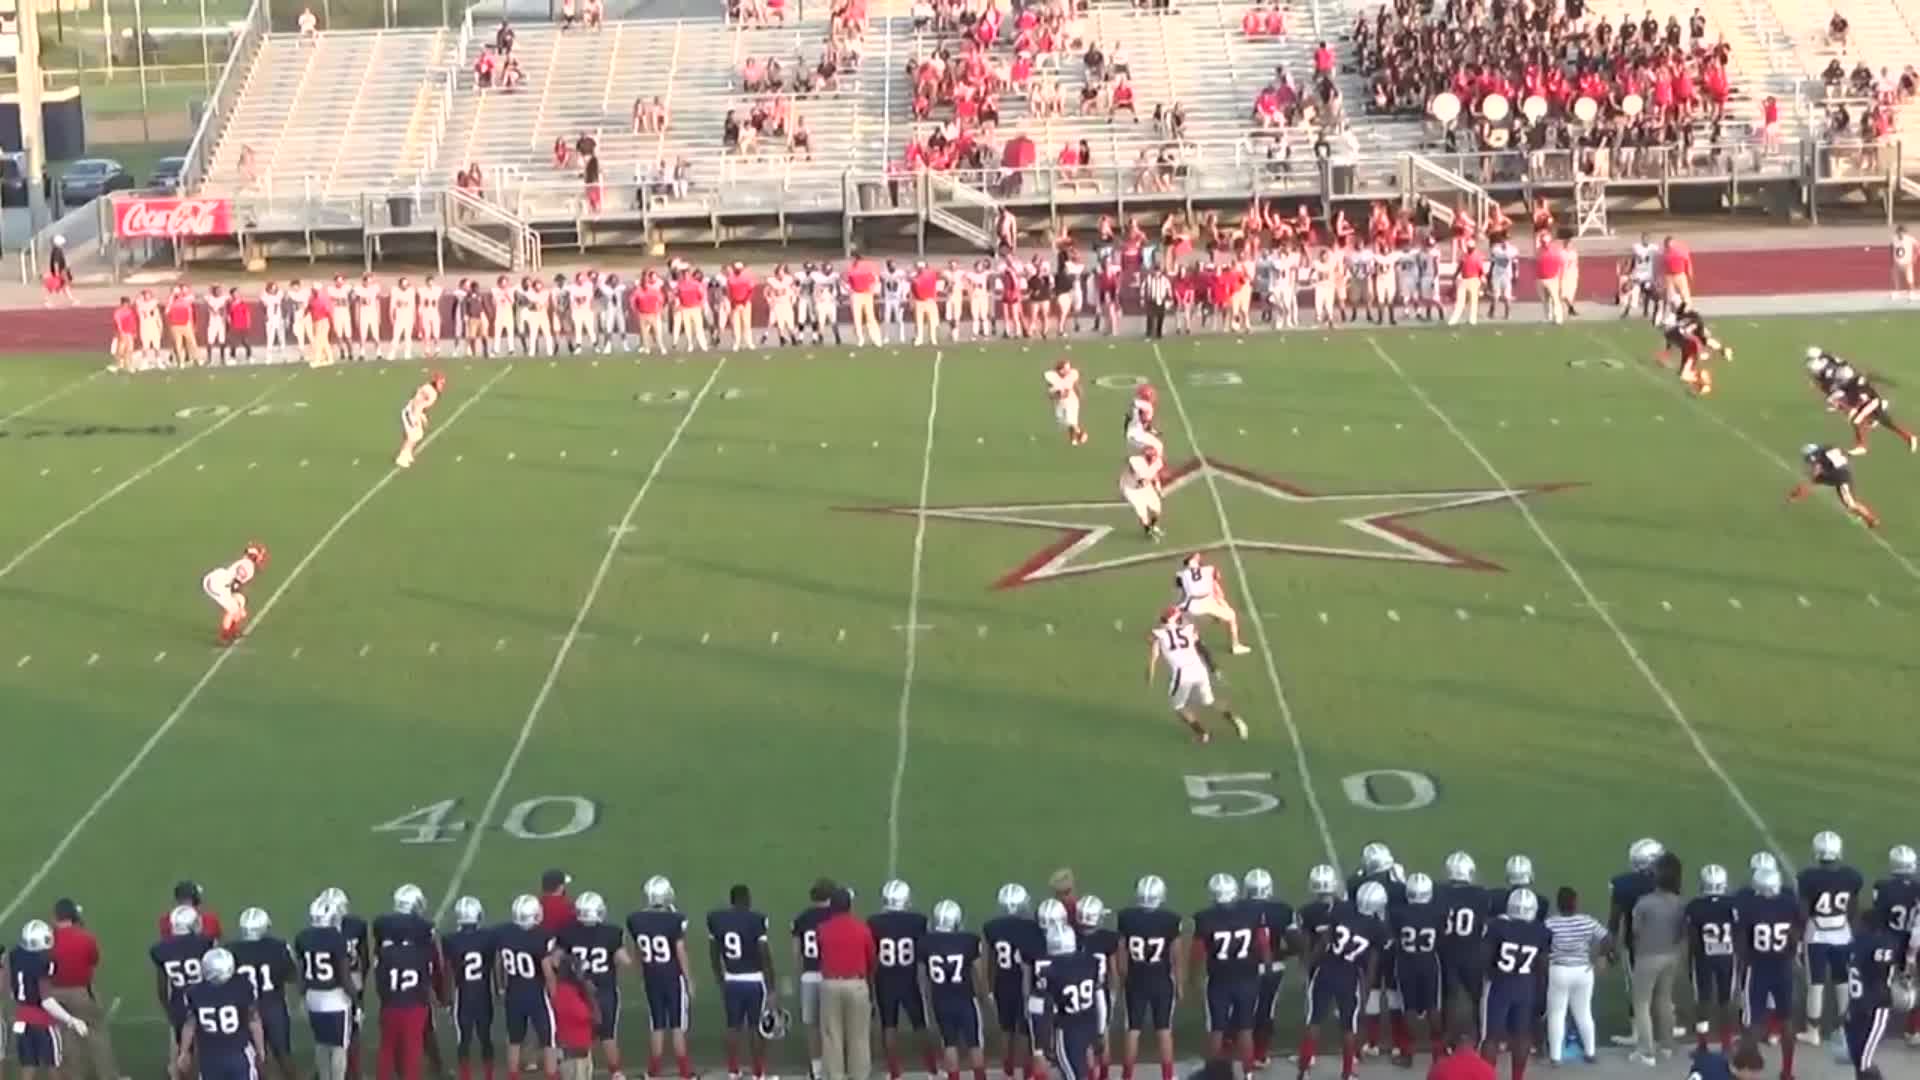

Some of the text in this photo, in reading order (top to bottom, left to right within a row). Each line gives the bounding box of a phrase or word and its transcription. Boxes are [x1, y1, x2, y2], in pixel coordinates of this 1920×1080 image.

[1167, 627, 1189, 651] 15
[637, 934, 671, 963] 99
[724, 931, 742, 959] 9
[880, 937, 914, 966] 88
[1214, 928, 1252, 960] 77
[1332, 925, 1369, 961] 37
[1401, 926, 1436, 952] 23
[1753, 923, 1790, 951] 85
[164, 957, 202, 987] 59
[304, 951, 333, 981] 15
[465, 952, 483, 981] 2
[571, 946, 608, 974] 72
[928, 953, 963, 984] 67
[1497, 942, 1538, 975] 57
[1062, 979, 1094, 1014] 39
[198, 1005, 239, 1034] 58
